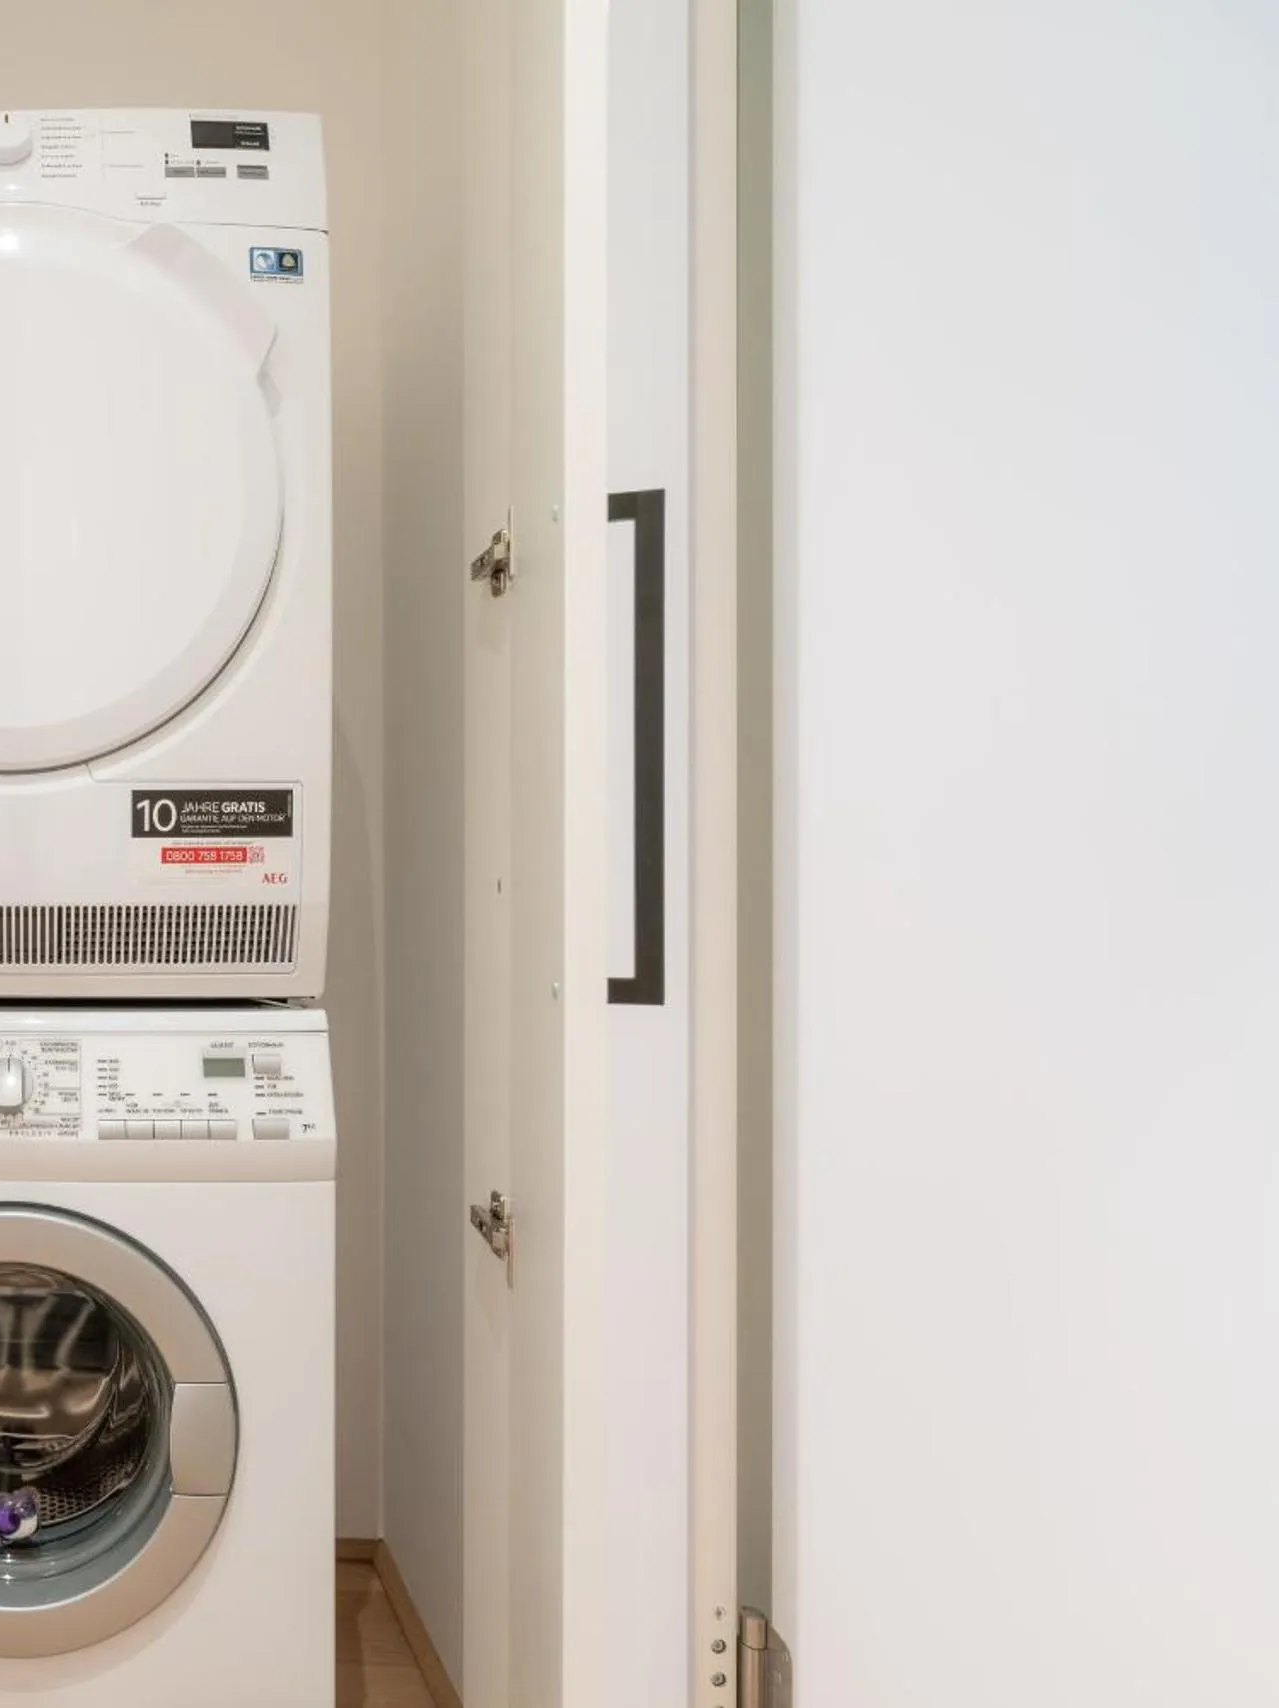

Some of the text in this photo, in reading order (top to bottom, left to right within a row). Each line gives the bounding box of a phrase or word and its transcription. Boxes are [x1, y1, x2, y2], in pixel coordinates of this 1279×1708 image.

[181, 801, 266, 813] JAHRE GRATIS
[136, 799, 177, 832] 10
[166, 851, 194, 861] 0800
[262, 873, 288, 884] AEG
